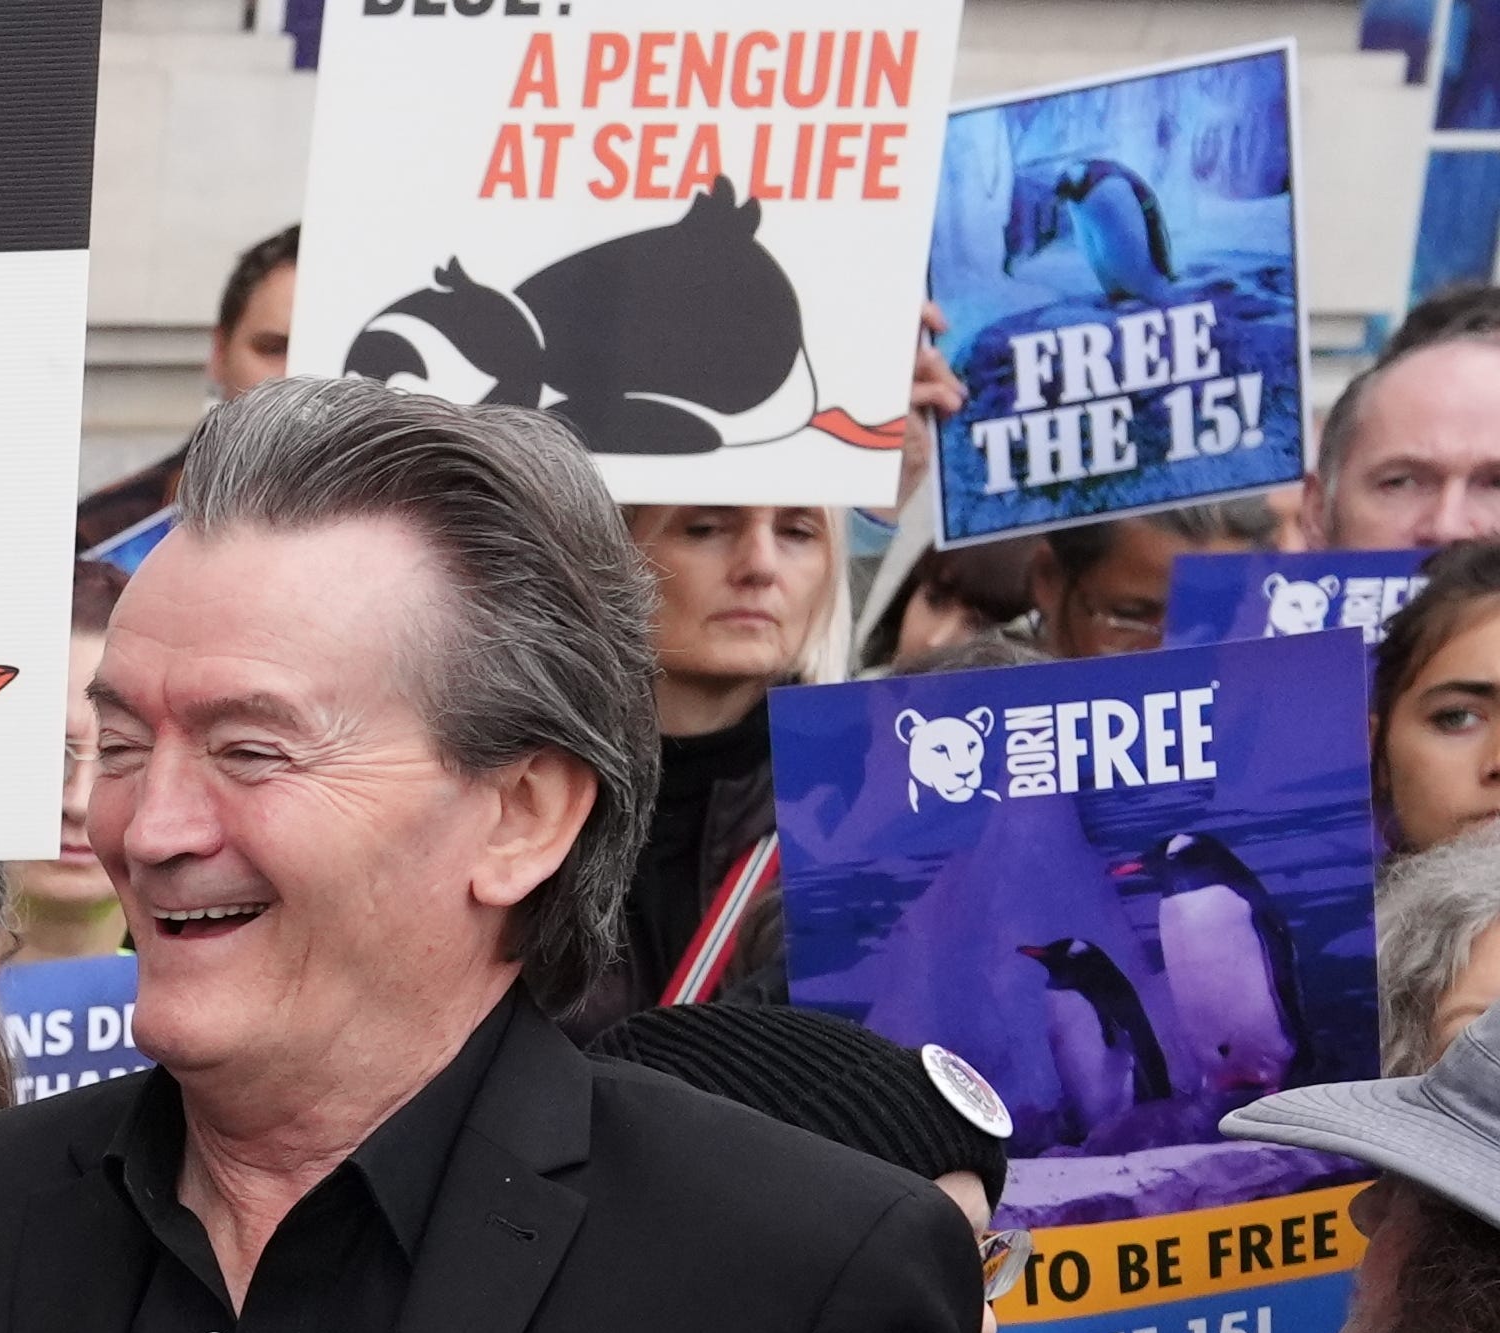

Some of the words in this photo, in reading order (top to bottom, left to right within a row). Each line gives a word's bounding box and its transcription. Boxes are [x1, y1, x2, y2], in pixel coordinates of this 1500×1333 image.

[508, 33, 559, 108] A
[581, 30, 918, 108] PENGUIN
[478, 123, 573, 199] AT
[587, 123, 723, 200] SEA
[751, 123, 907, 200] LIFE
[1008, 300, 1220, 412] FREE
[971, 397, 1138, 495] THE
[1163, 371, 1265, 462] 15!
[1004, 704, 1058, 799] BORN
[1023, 1248, 1092, 1307] TO
[1116, 1236, 1183, 1295] BE
[1208, 1209, 1339, 1280] FREE
